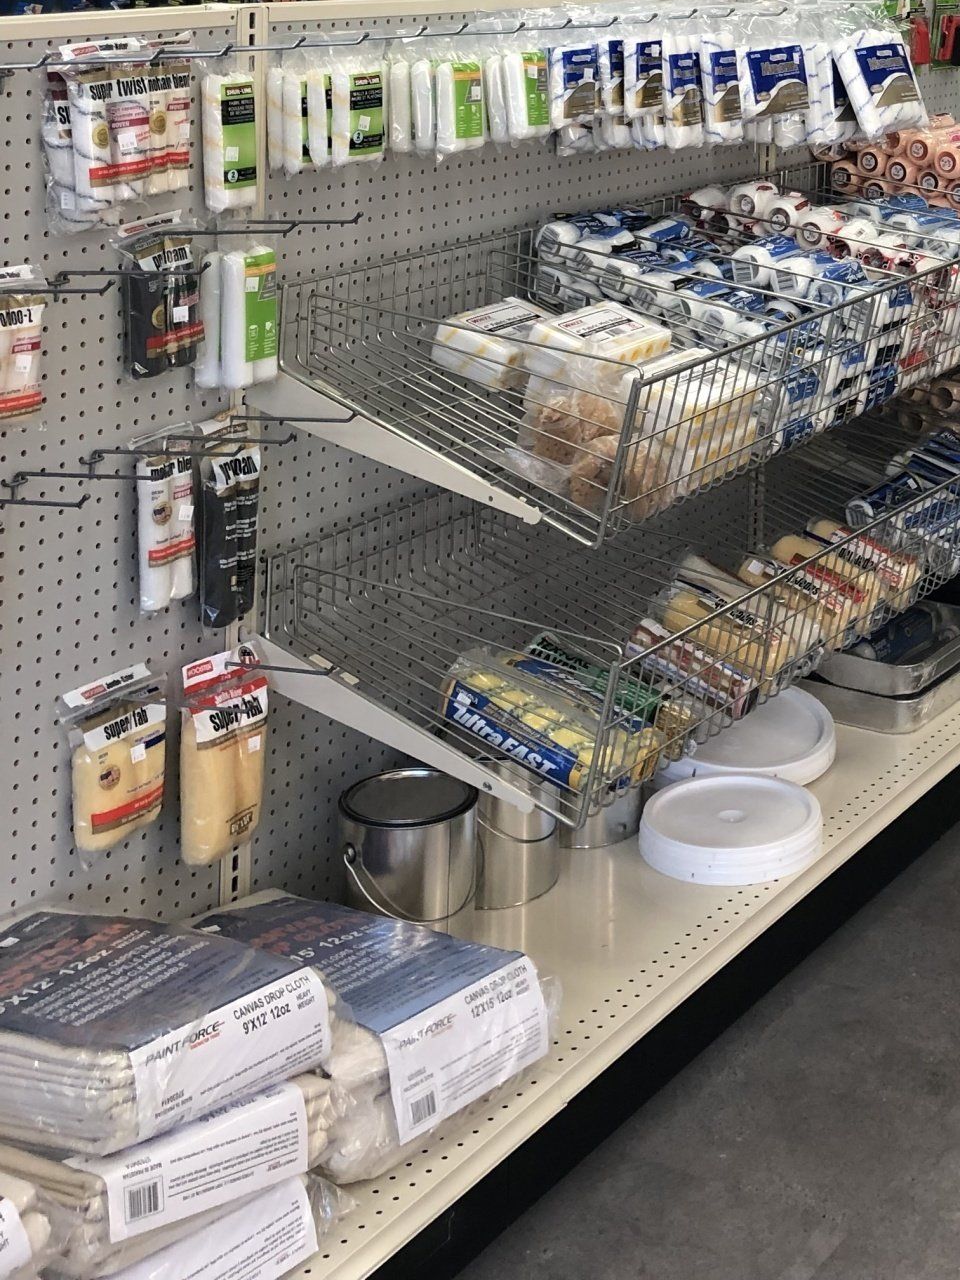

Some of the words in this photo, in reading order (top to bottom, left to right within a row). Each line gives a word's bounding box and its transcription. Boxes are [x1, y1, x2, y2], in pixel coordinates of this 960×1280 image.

[116, 76, 147, 98] twist
[319, 928, 363, 948] 12oz
[59, 949, 112, 975] 12oz
[233, 997, 265, 1020] CANVAS
[264, 987, 286, 1005] DROP
[286, 975, 311, 995] CLOTH
[464, 983, 489, 1005] CANVAS
[270, 1003, 291, 1020] 12oz
[145, 1039, 182, 1067] PAINT
[182, 1020, 222, 1048] FORCE
